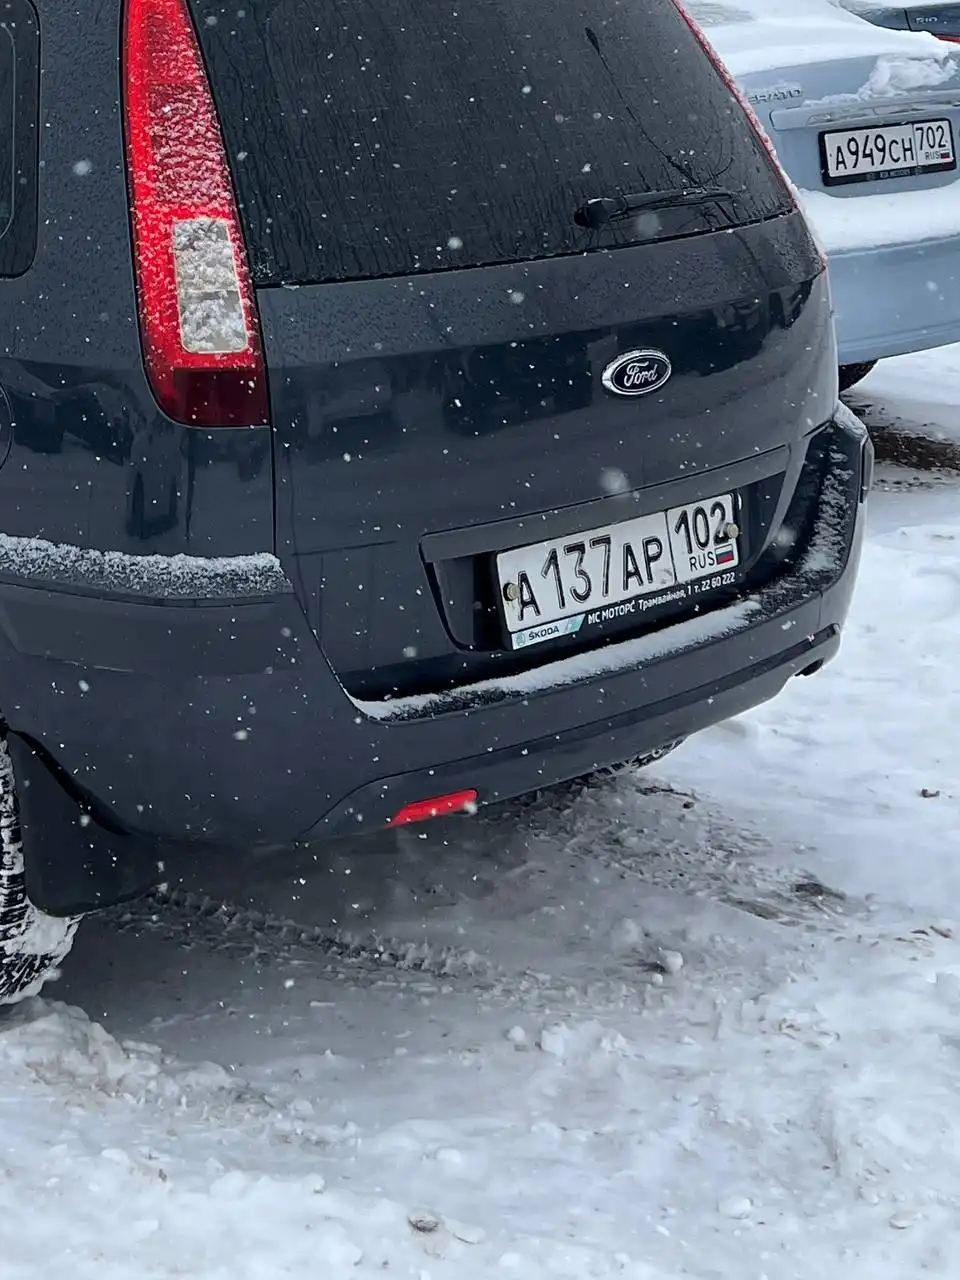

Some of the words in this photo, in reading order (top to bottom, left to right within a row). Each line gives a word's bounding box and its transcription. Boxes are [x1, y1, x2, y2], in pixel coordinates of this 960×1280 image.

[747, 89, 801, 105] ERATO
[835, 133, 915, 171] А949СН
[915, 124, 947, 151] 702
[924, 150, 941, 161] RUS
[623, 360, 658, 387] Ford
[517, 534, 663, 621] А137АР
[673, 500, 728, 554] 102
[688, 550, 716, 573] RUS
[587, 610, 601, 625] МС
[601, 599, 636, 620] МОТОРС
[701, 580, 711, 592] 22
[722, 571, 735, 585] 222
[528, 624, 560, 641] ŠKODA
